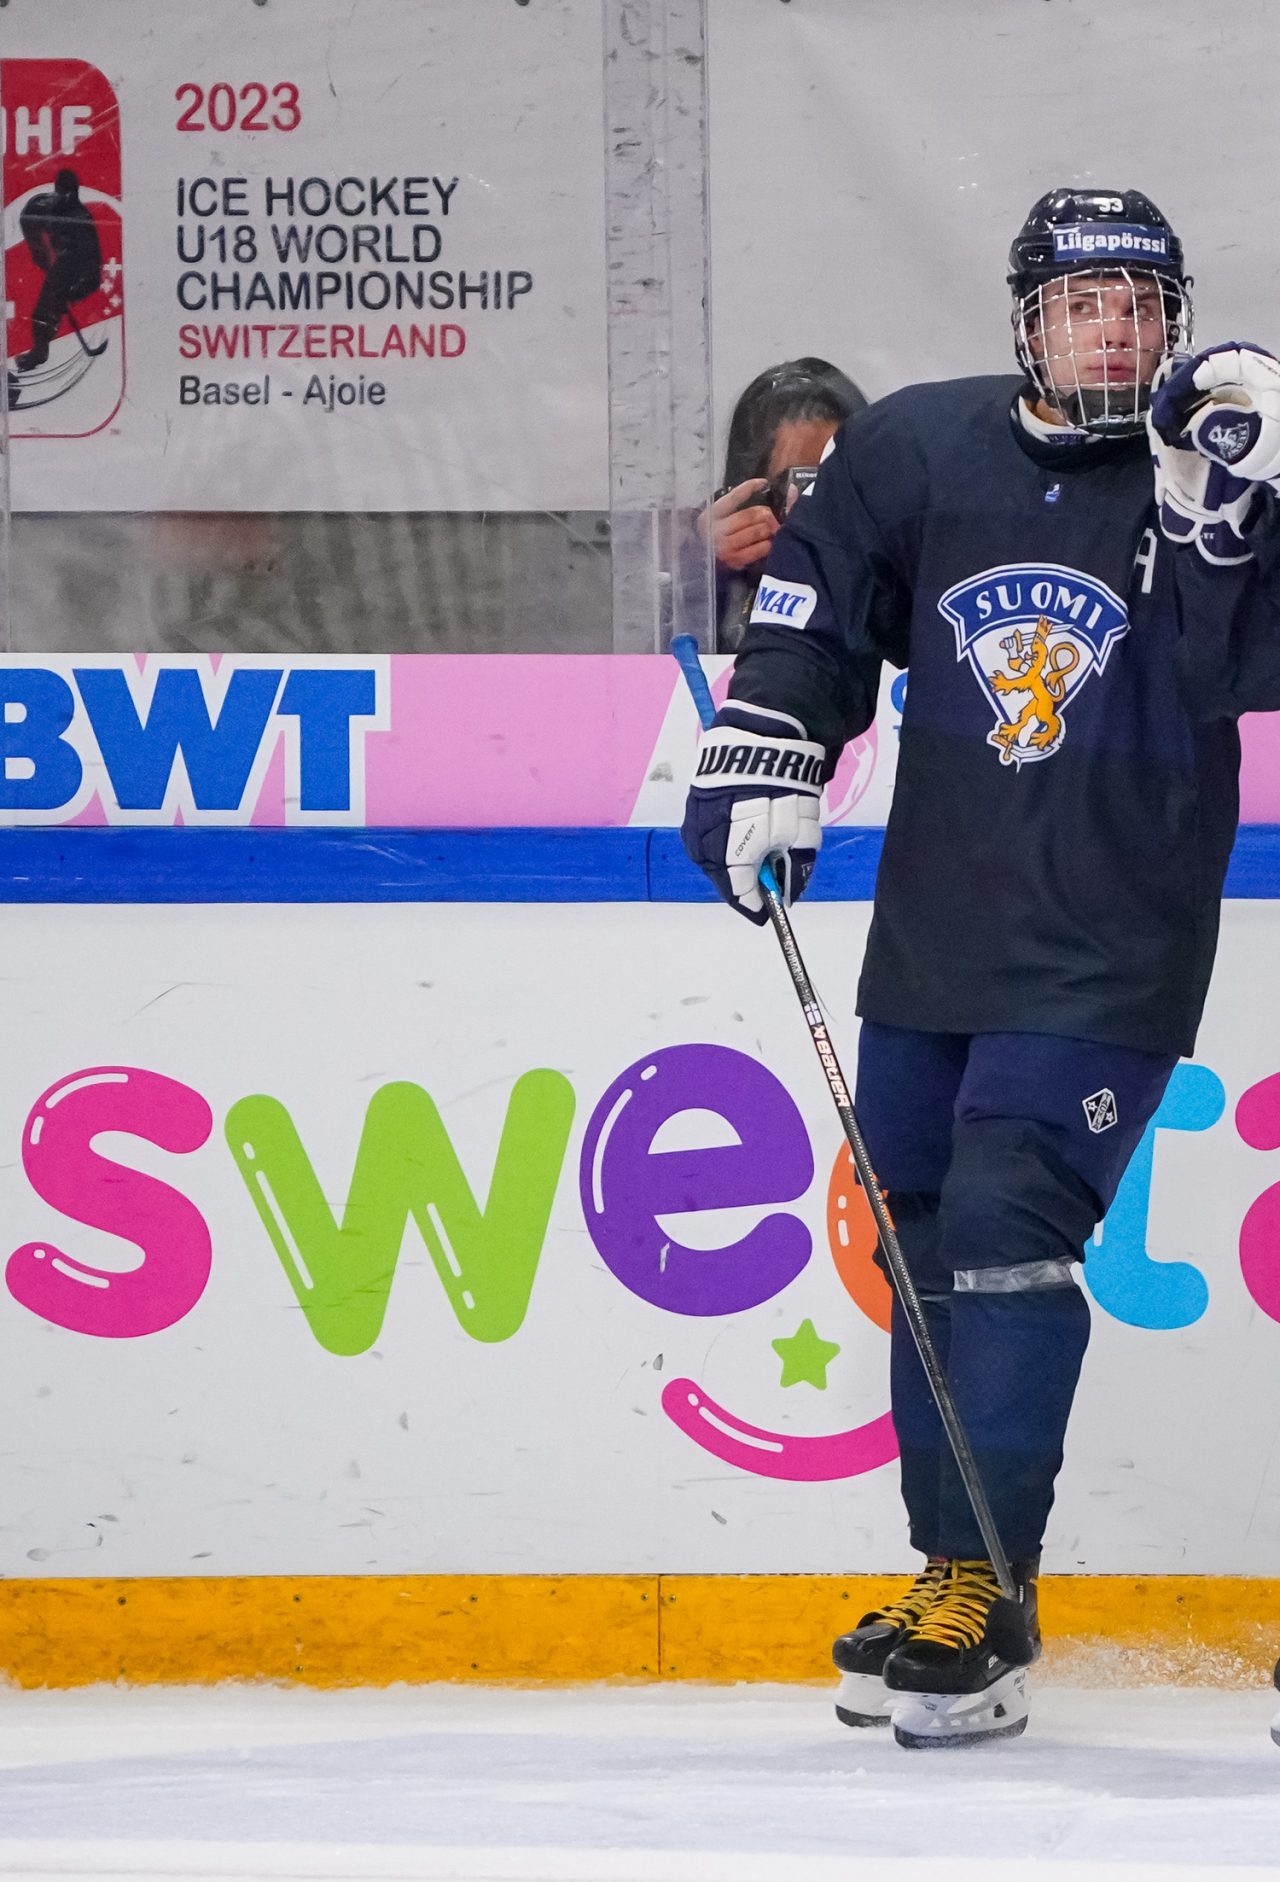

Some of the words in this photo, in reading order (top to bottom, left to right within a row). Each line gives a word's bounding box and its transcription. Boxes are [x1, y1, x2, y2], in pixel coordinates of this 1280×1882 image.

[174, 82, 302, 132] 2023
[176, 177, 248, 217] ICE
[265, 175, 460, 217] HOCKEY
[176, 224, 257, 264] U18
[271, 222, 442, 264] WORLD
[1056, 232, 1166, 254] Liigapörssi
[176, 269, 534, 312] CHAMPIONSHIP
[178, 322, 467, 360] SWITZERLAND
[179, 374, 271, 406] Basel
[303, 376, 387, 413] Ajoie
[975, 581, 1103, 630] SUOMI
[0, 669, 376, 811] BWT
[734, 823, 758, 857] COVERT
